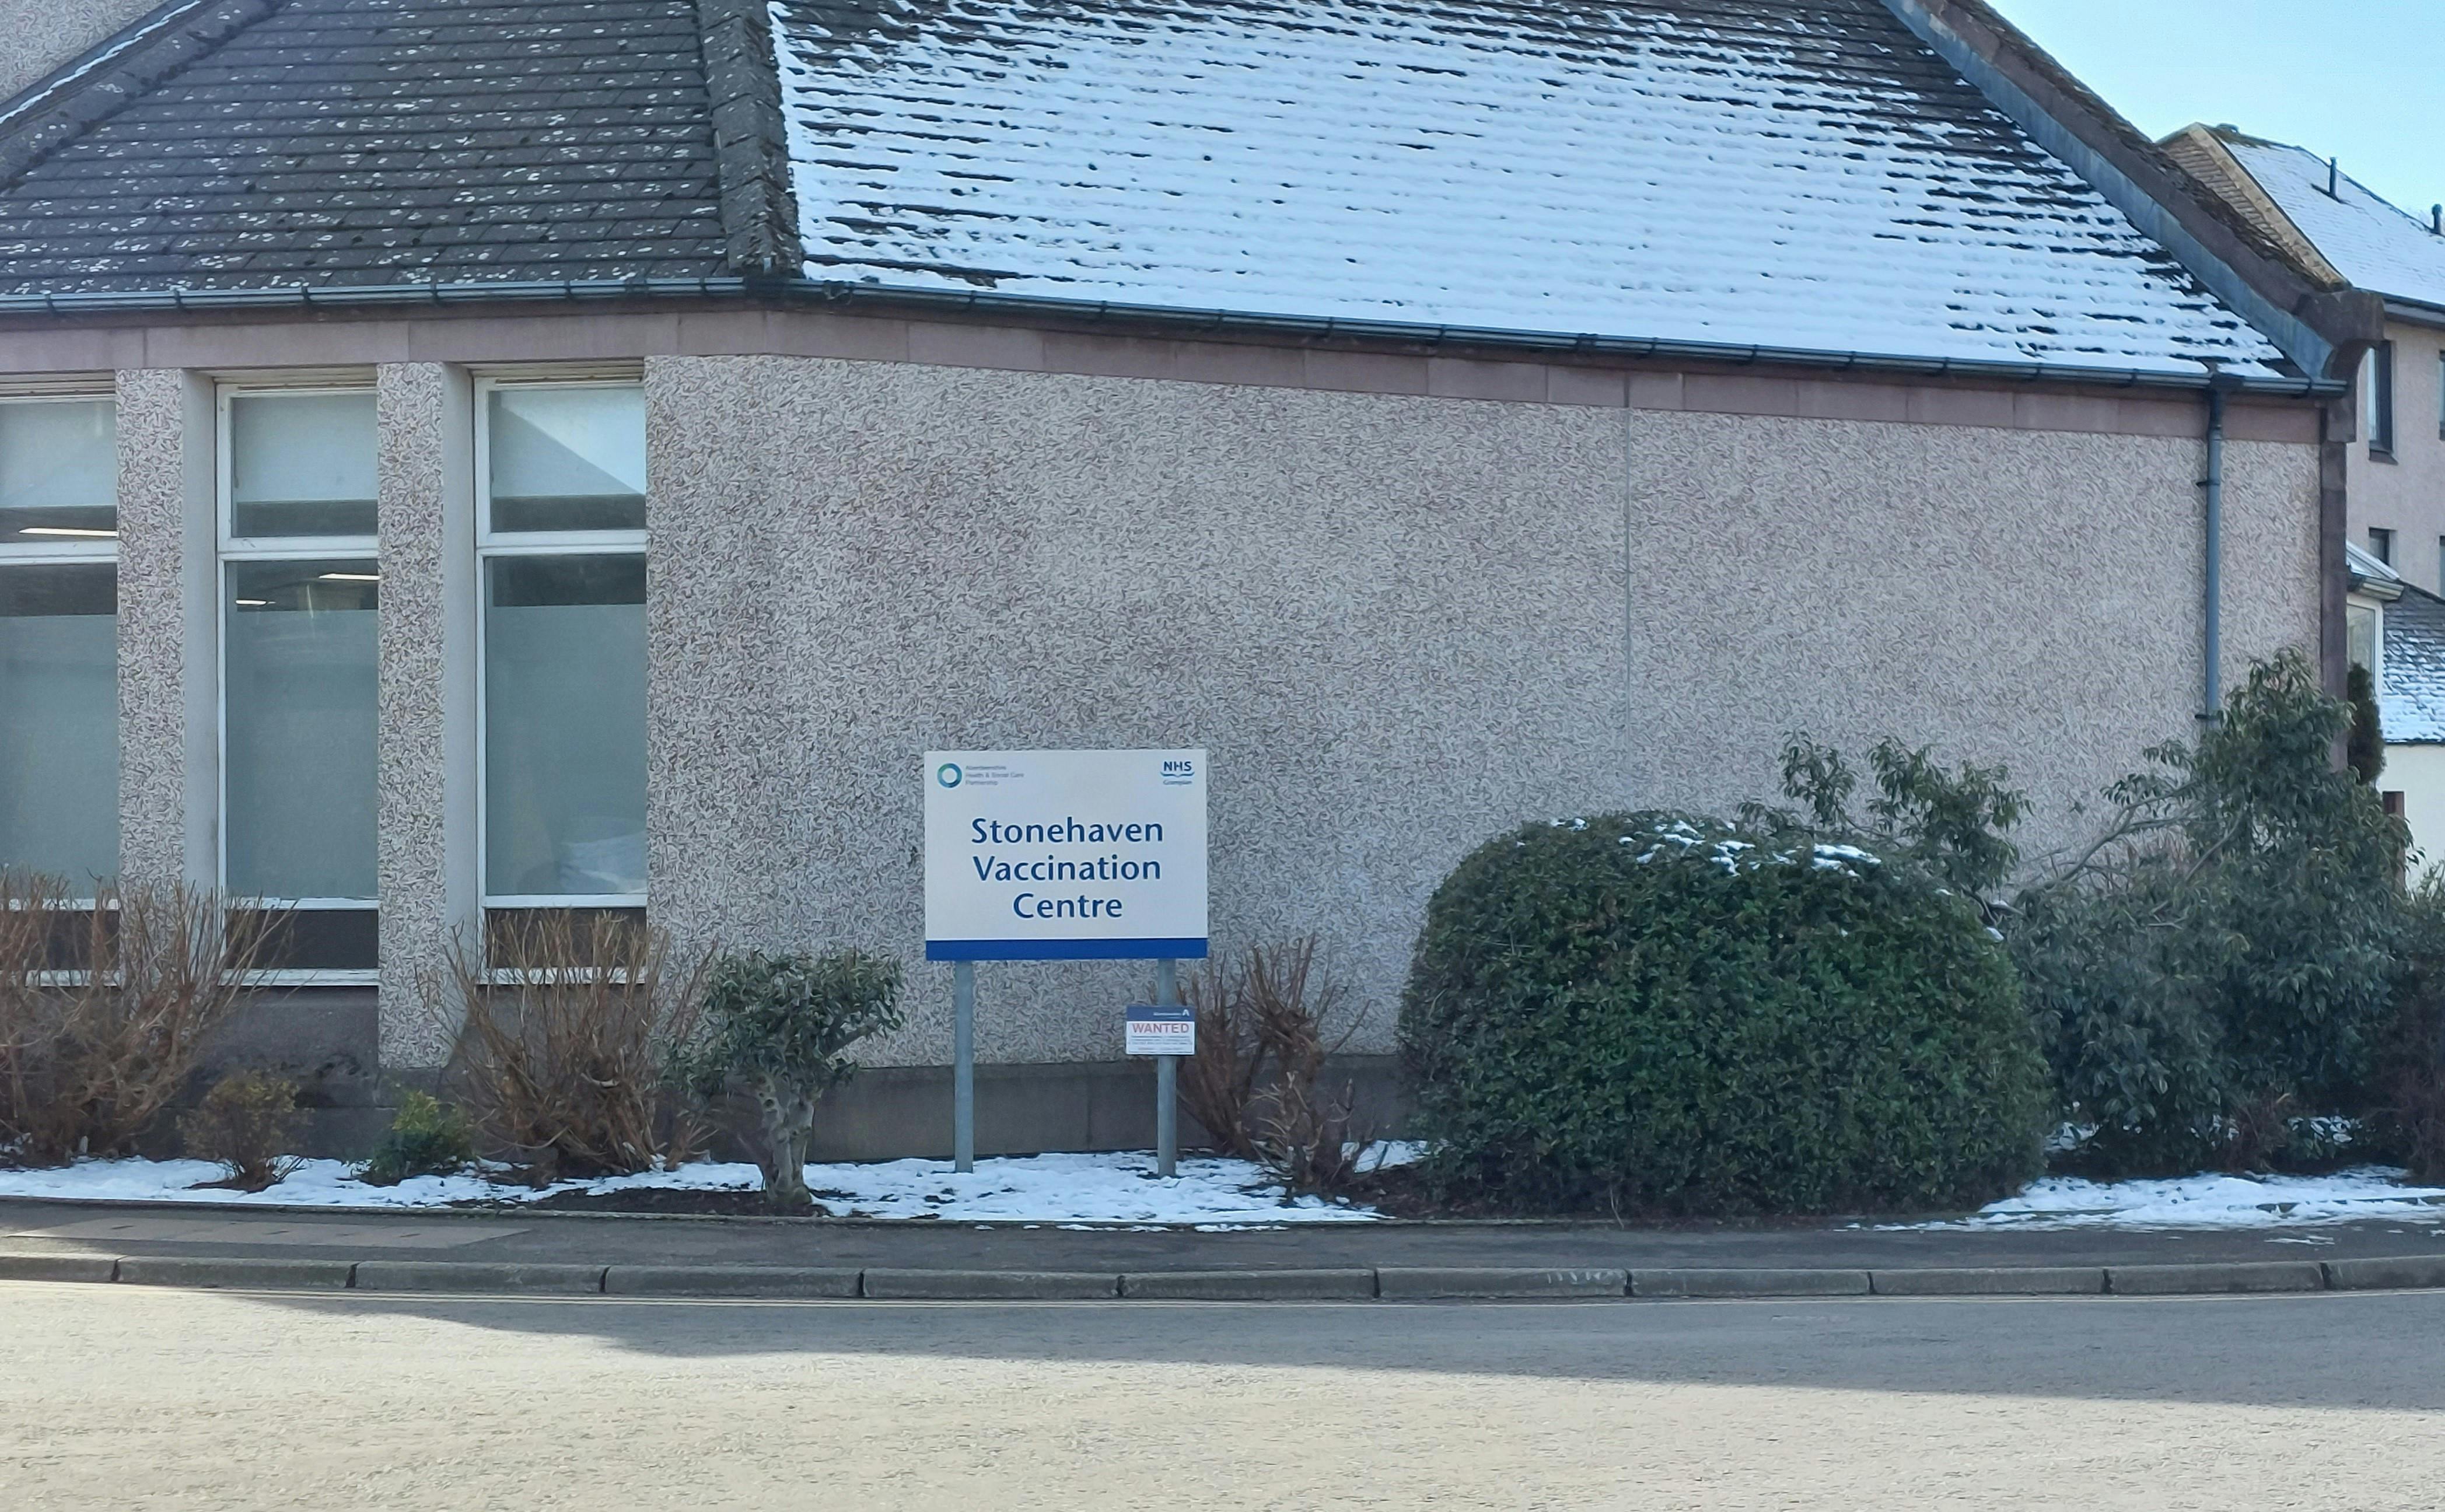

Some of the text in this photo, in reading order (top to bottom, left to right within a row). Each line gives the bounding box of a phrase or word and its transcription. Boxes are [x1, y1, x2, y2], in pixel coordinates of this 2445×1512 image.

[1164, 761, 1192, 771] NHS
[971, 817, 1163, 844] Stonehaven
[973, 854, 1160, 881] Vaccination
[1013, 893, 1122, 919] Centre
[1132, 1023, 1189, 1033] WANTED
